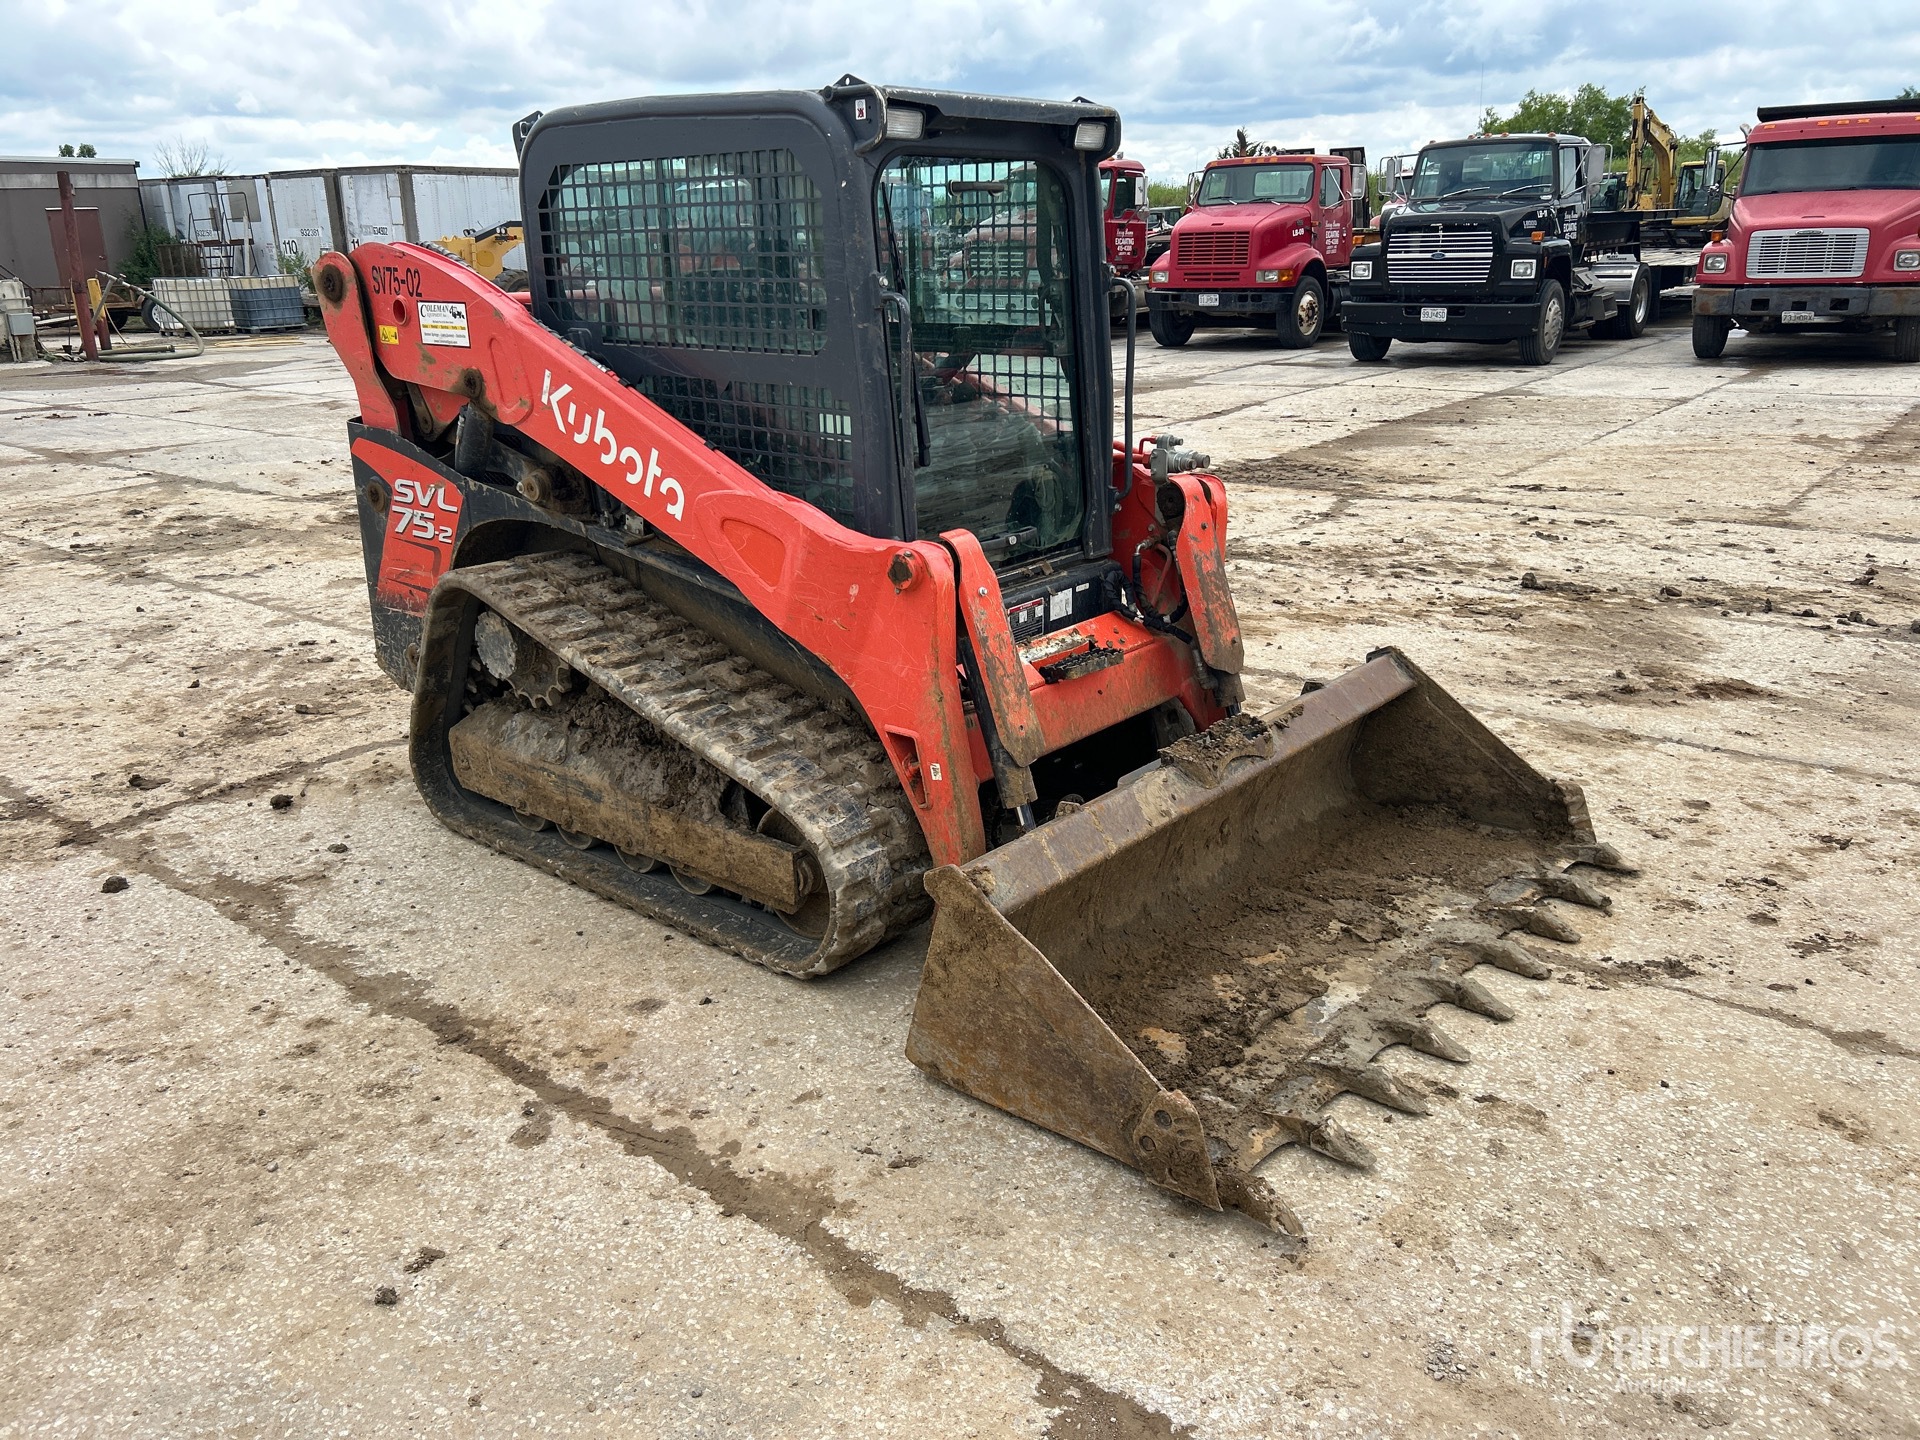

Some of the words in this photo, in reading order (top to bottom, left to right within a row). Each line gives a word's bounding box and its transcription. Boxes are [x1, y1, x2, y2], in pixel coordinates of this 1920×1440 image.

[283, 240, 298, 254] 110
[372, 265, 423, 297] SV75-02
[421, 304, 450, 318] COLEMAN
[541, 369, 685, 522] Kubota
[393, 478, 458, 513] SVL
[391, 505, 453, 544] 75-2
